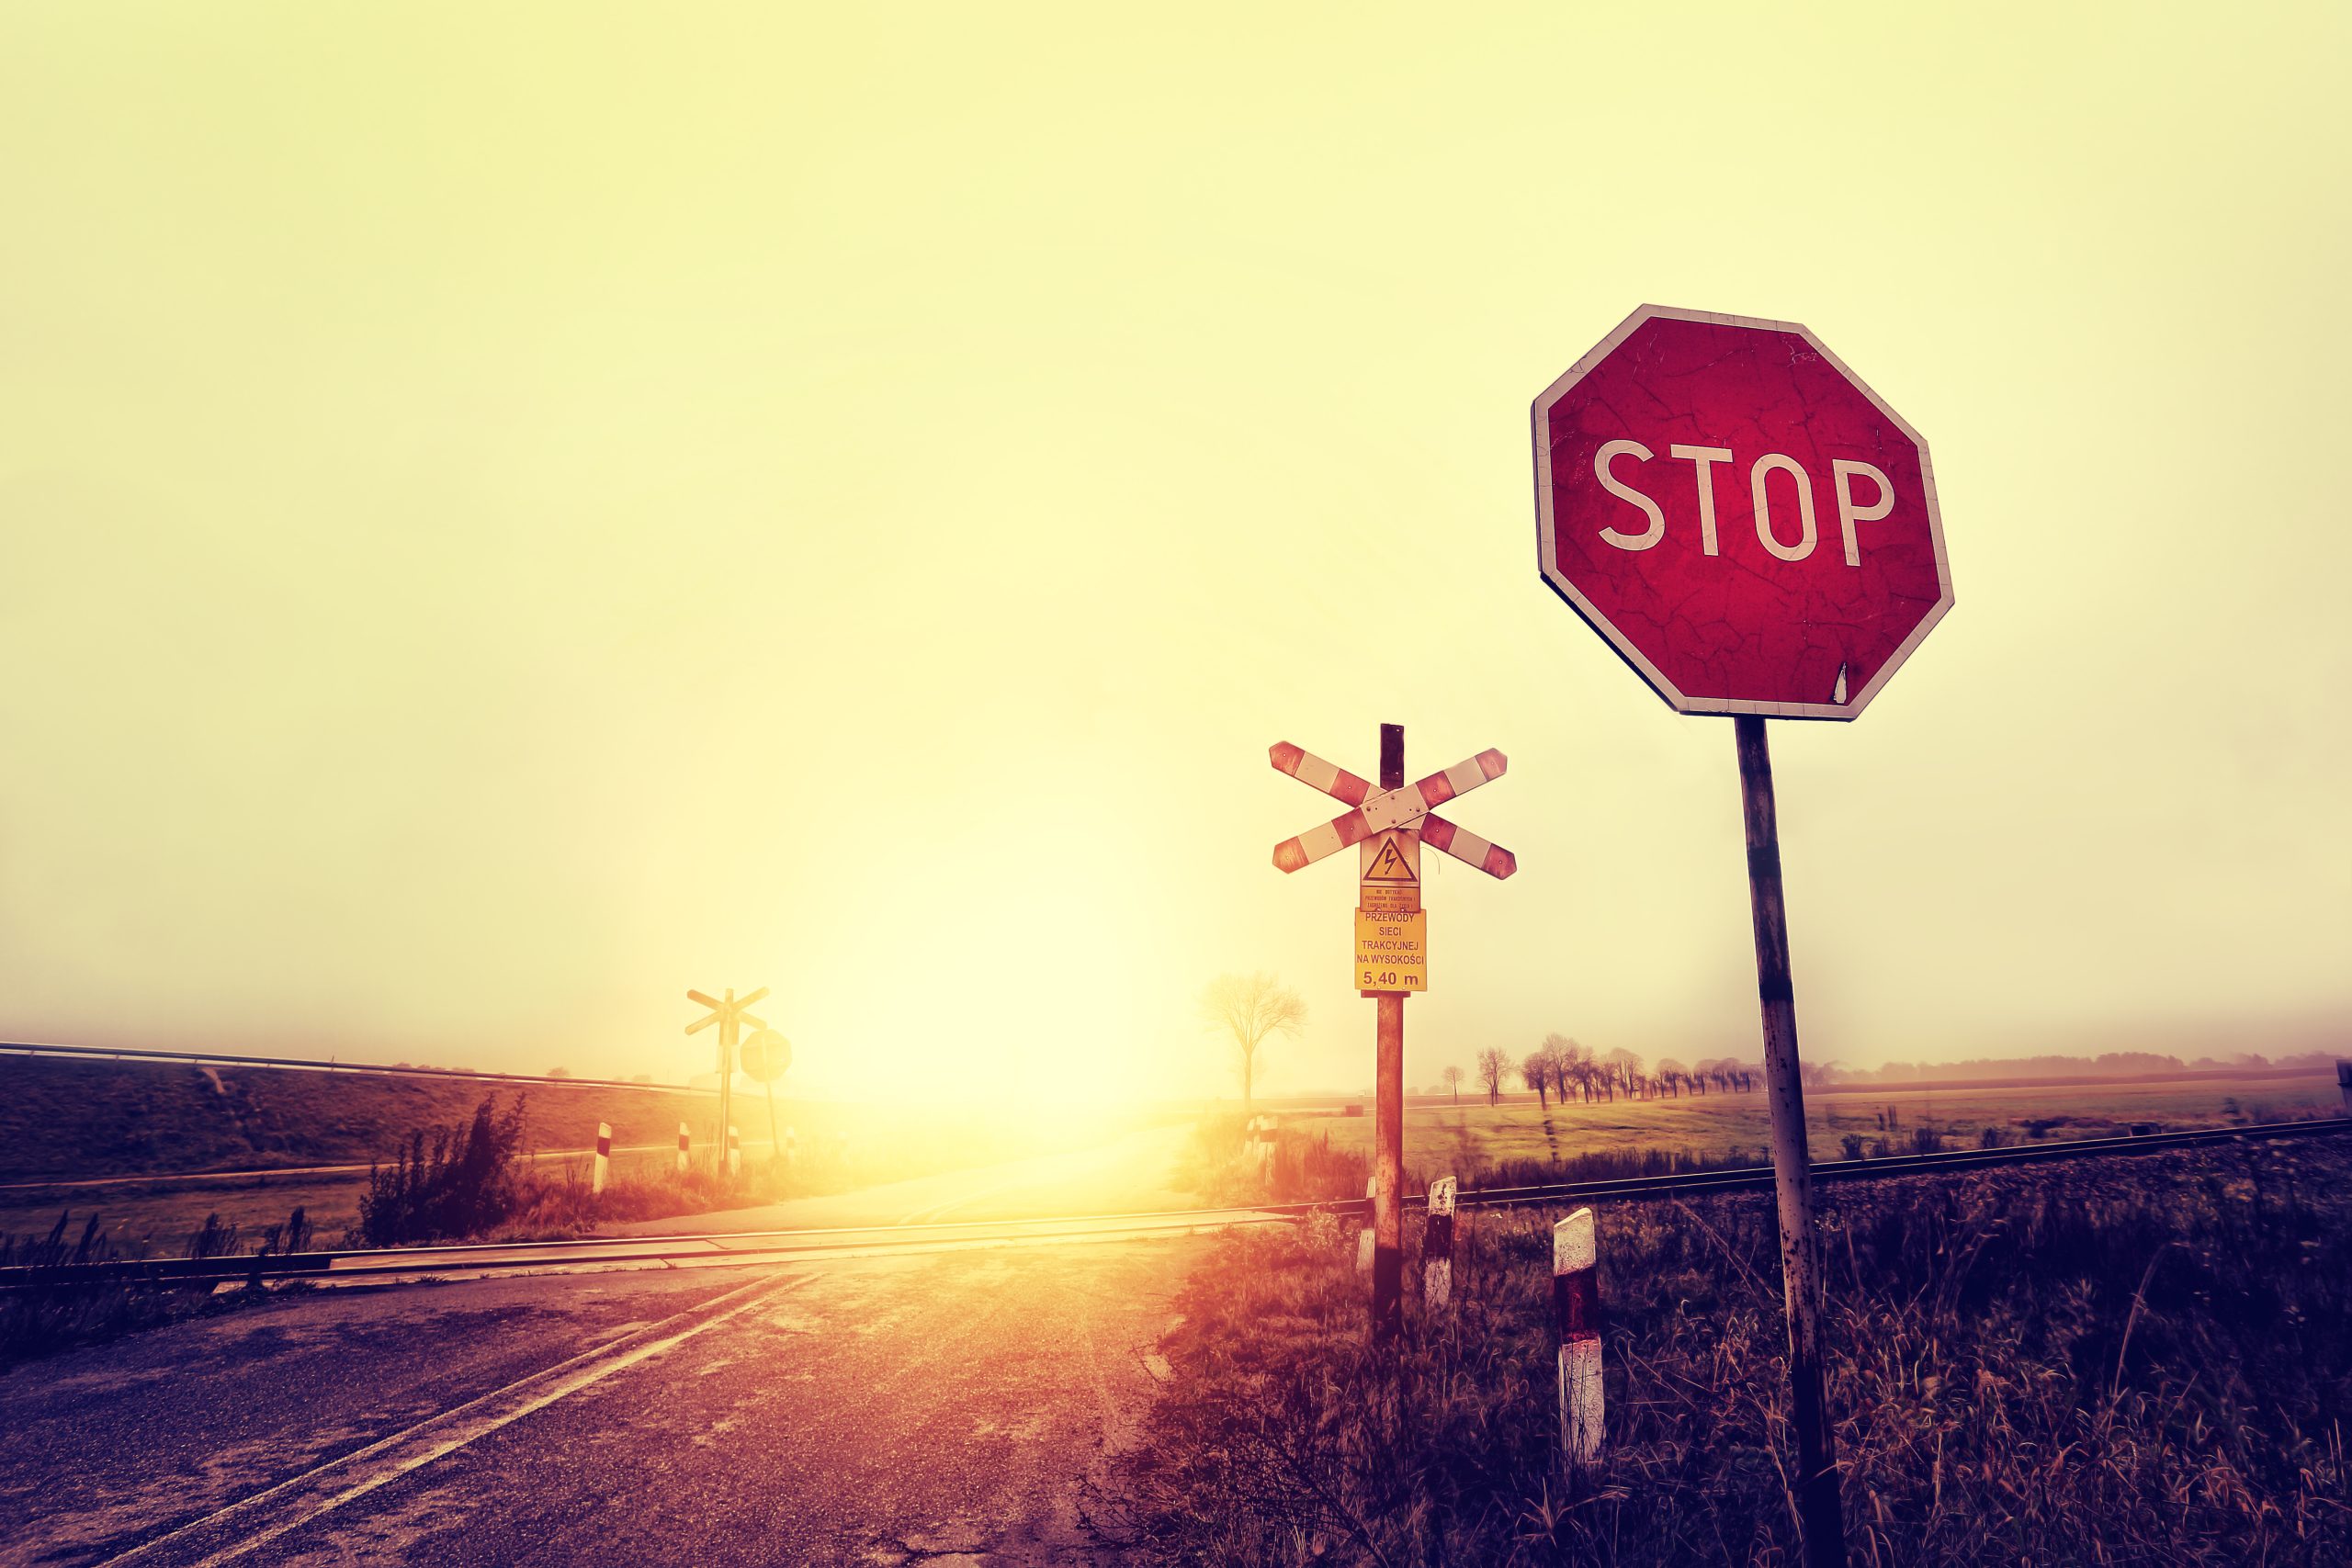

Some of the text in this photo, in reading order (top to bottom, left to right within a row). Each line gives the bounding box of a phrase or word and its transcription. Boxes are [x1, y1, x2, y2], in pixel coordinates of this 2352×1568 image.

[1594, 439, 1895, 567] STOP
[1365, 912, 1415, 922] PRZEWODY
[1379, 926, 1402, 936] SIECI
[1362, 940, 1419, 951] TRAKCYJNEJ
[1356, 953, 1424, 965] NA WYSOKOŚCI
[1363, 971, 1419, 987] 5,40 m
